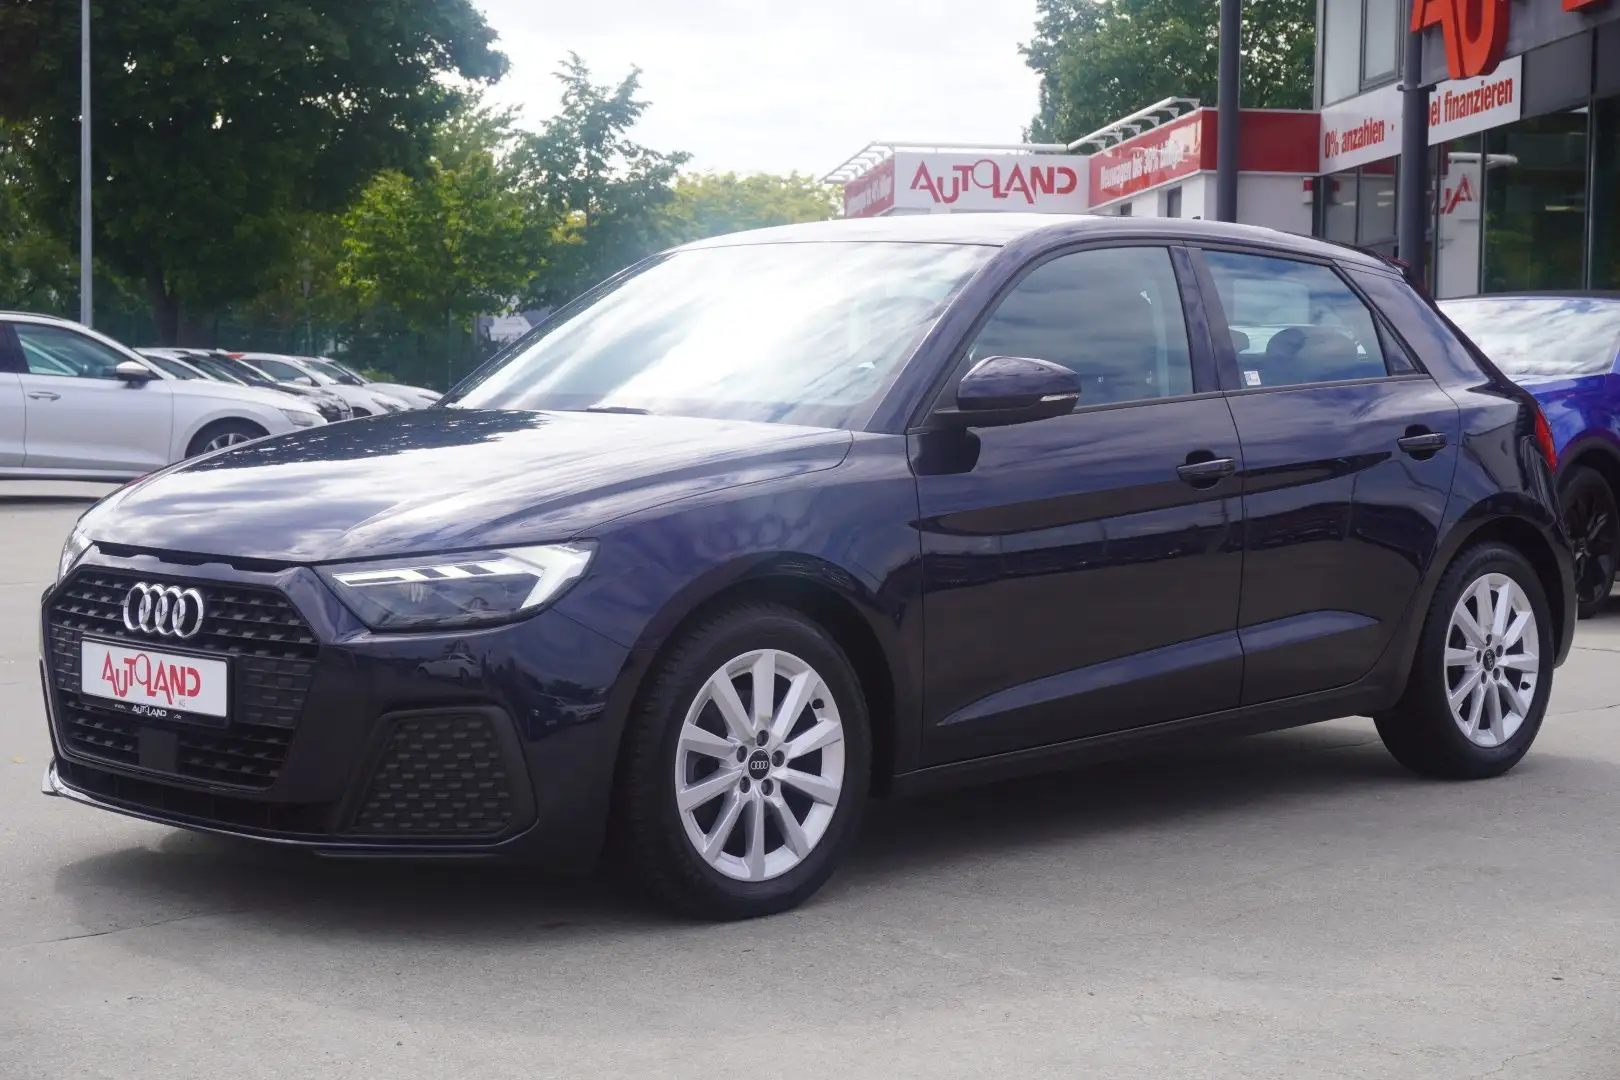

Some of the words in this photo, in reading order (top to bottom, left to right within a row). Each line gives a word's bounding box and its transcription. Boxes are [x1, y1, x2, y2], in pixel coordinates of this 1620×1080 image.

[1325, 128, 1339, 159] 0%
[1341, 117, 1385, 154] anzahlen
[1444, 78, 1513, 123] finanzieren
[910, 159, 1077, 204] AUTOLAND
[101, 650, 201, 705] AUTOLAND
